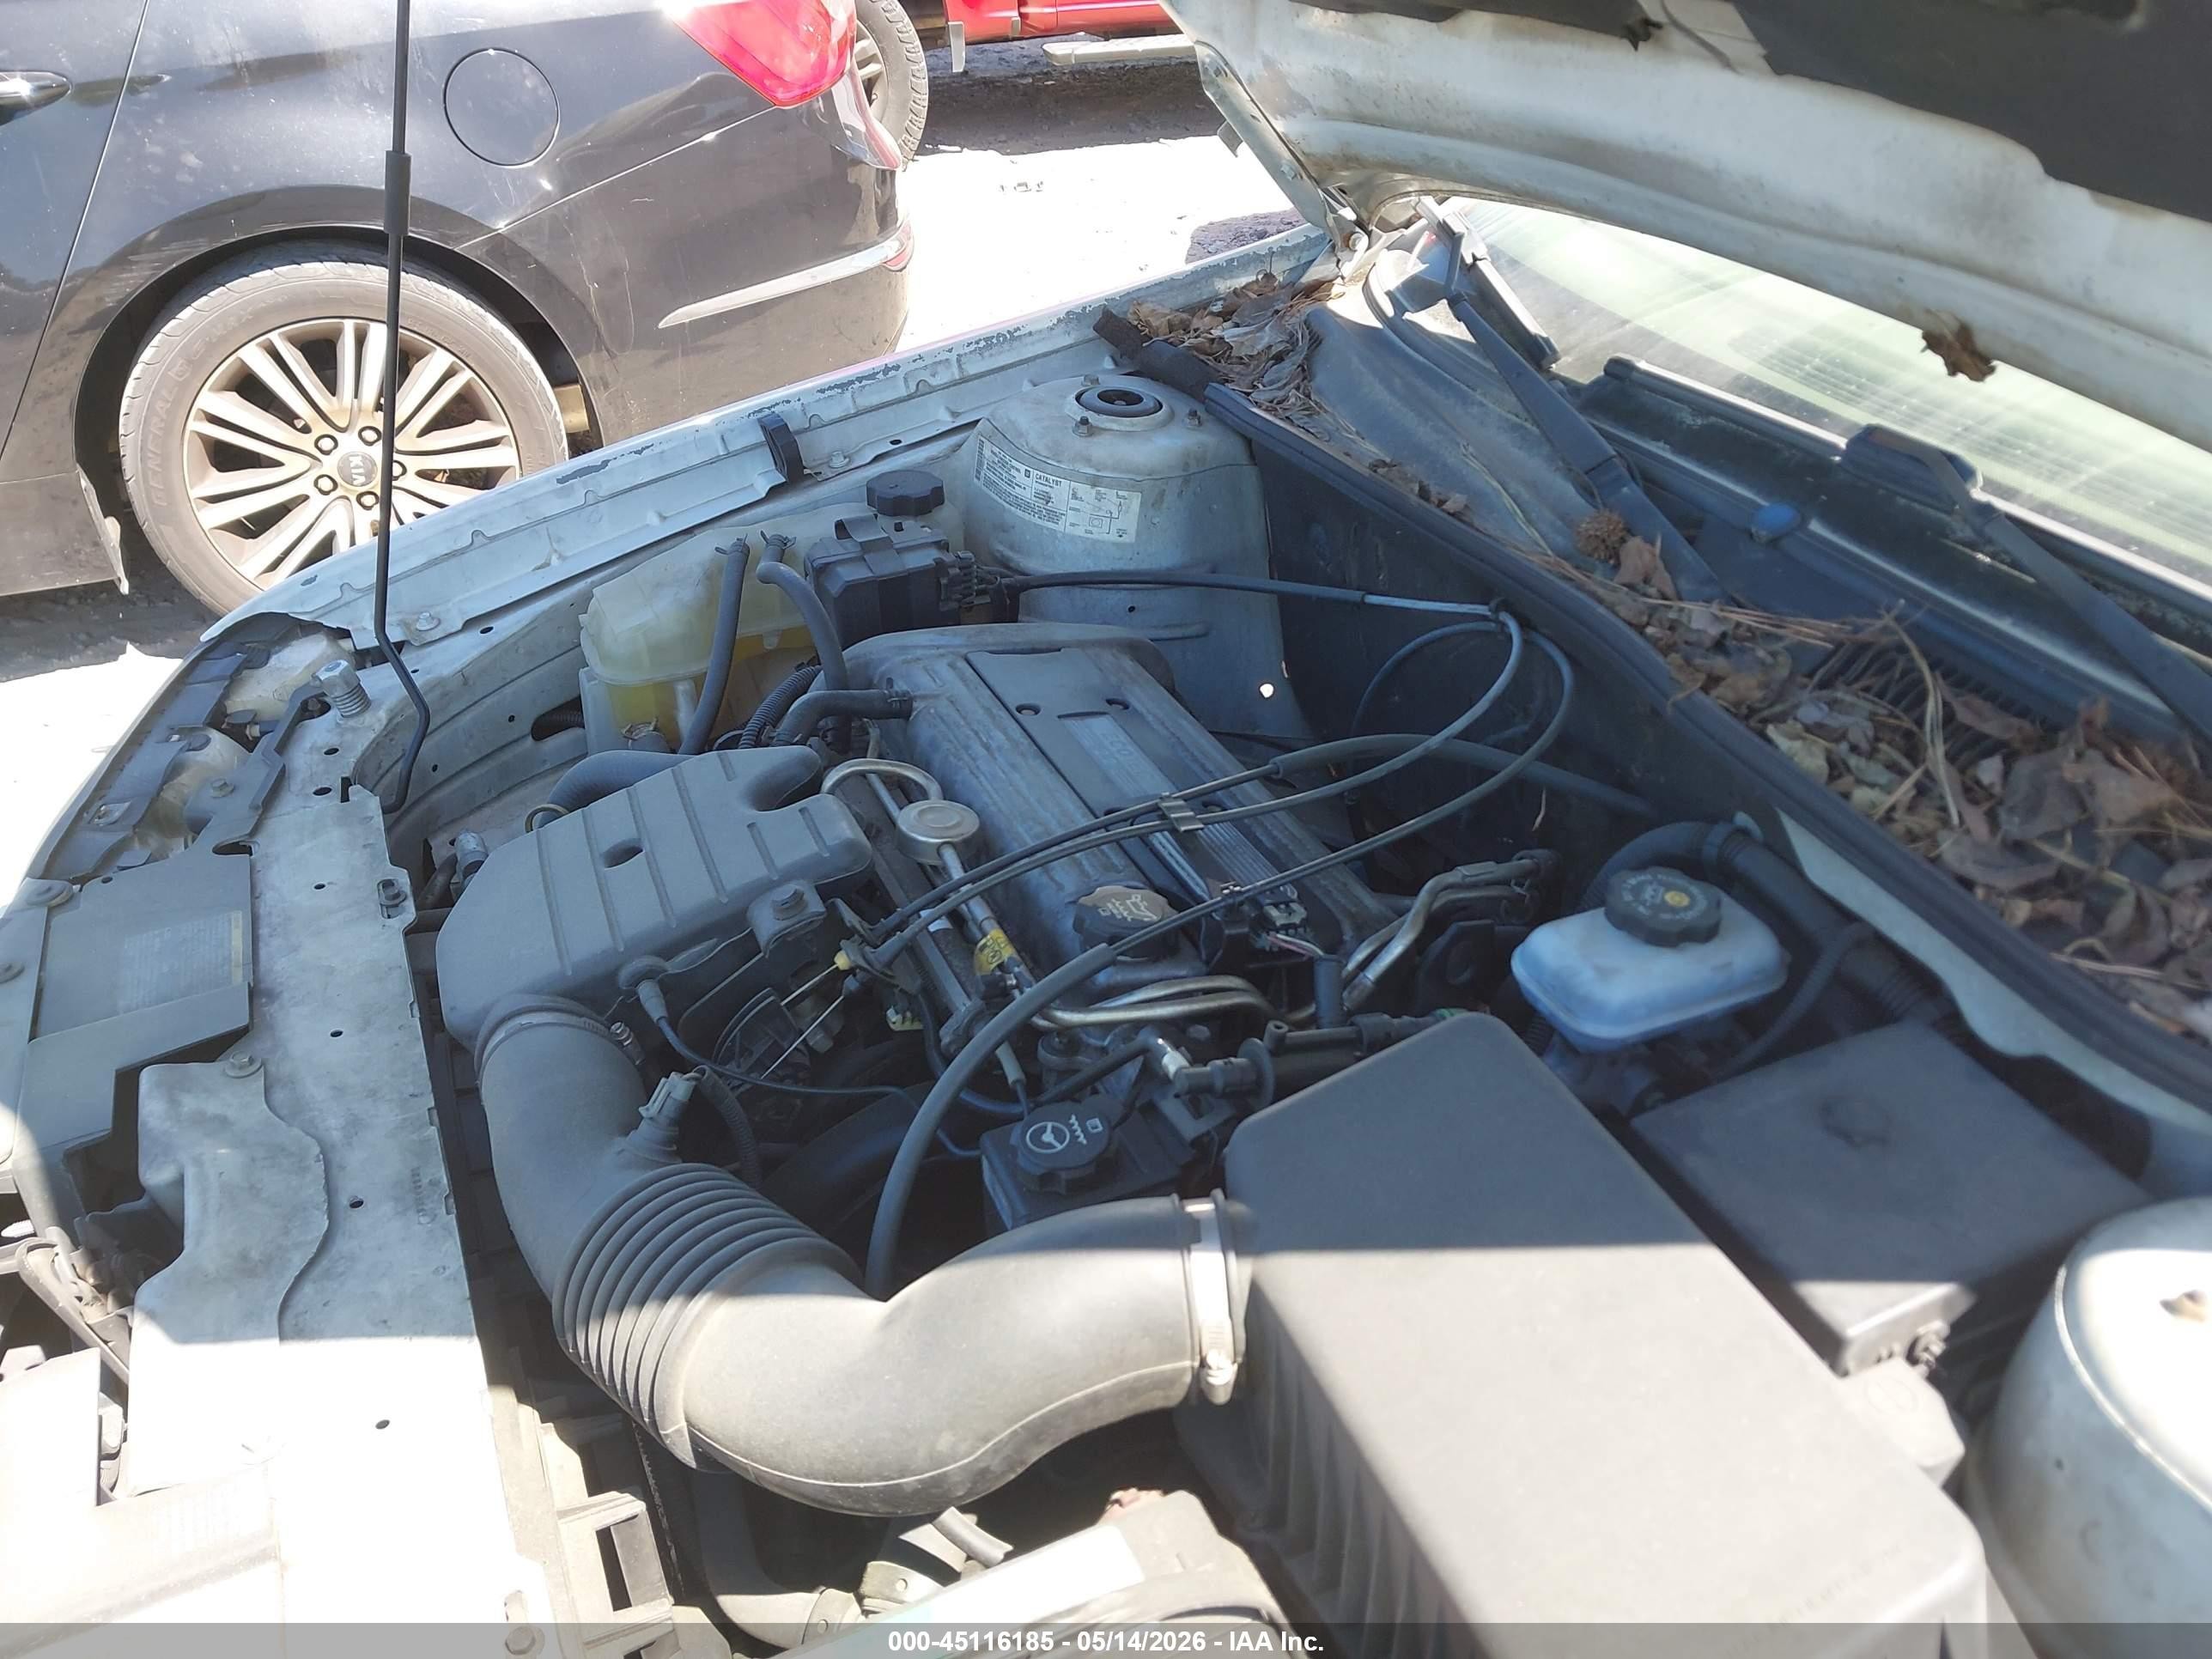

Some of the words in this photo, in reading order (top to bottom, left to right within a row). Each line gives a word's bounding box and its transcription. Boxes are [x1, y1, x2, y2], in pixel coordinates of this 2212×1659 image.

[147, 382, 179, 507] GENERAL
[348, 455, 366, 486] KIA
[1035, 473, 1062, 487] CATALYST
